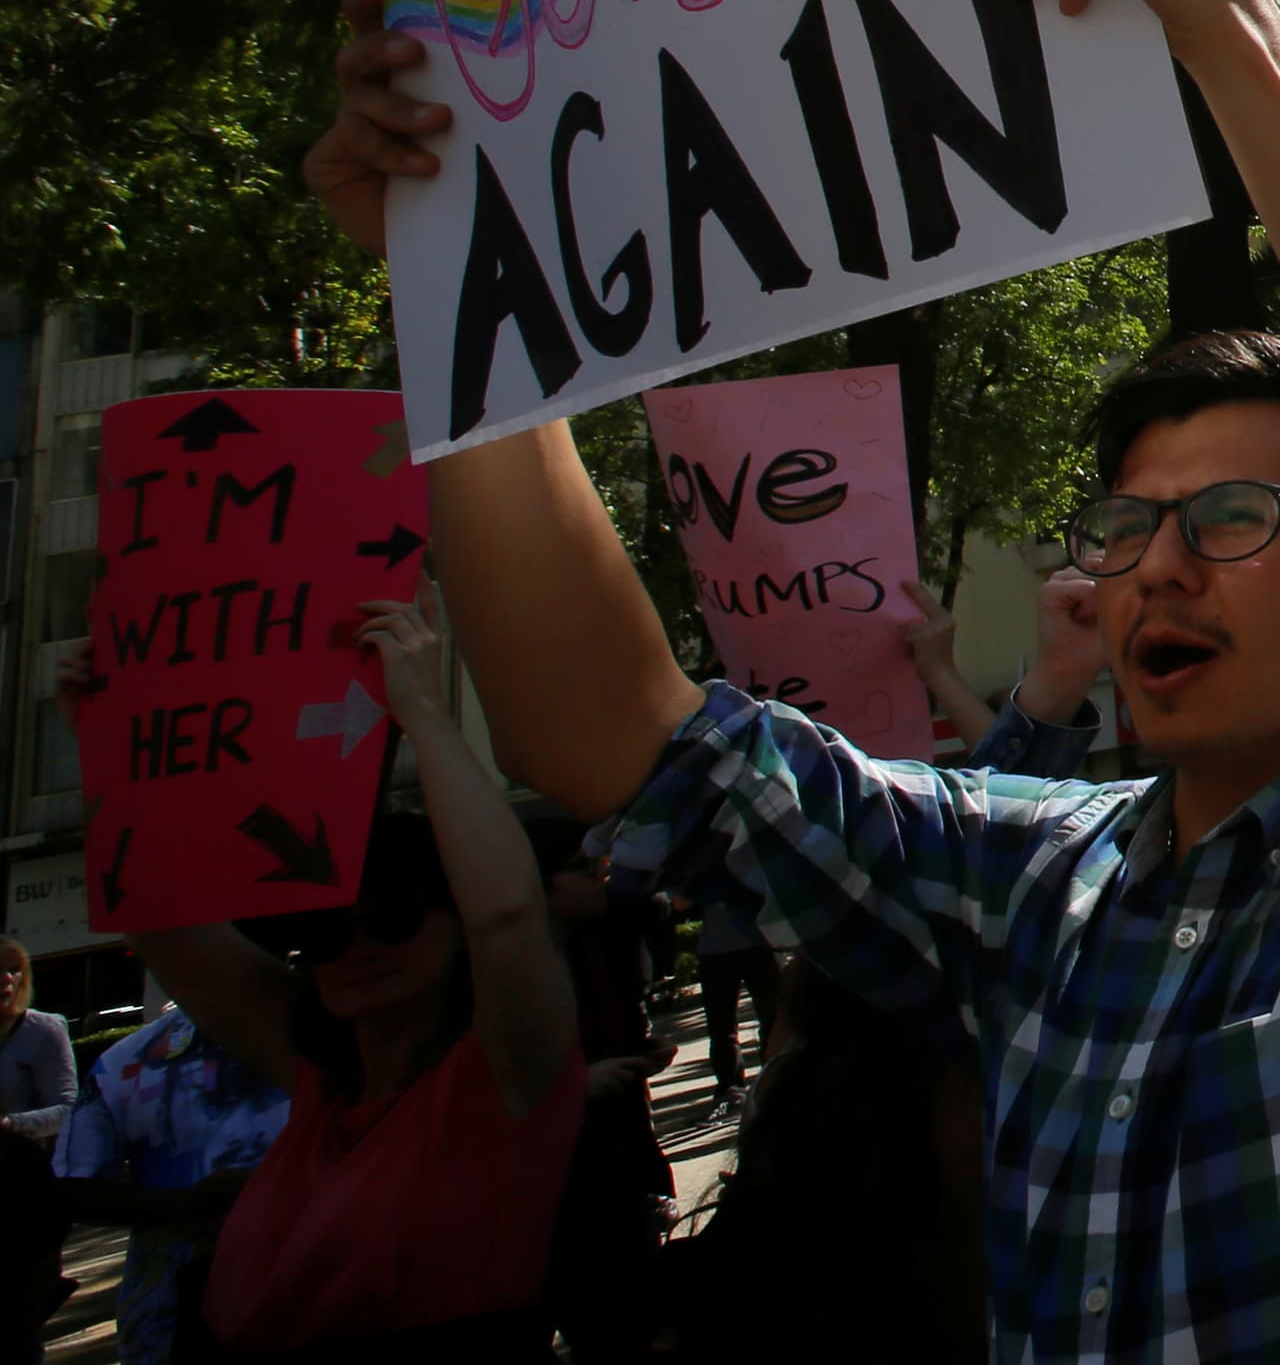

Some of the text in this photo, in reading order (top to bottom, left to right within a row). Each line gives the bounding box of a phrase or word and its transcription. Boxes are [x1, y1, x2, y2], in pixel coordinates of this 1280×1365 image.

[121, 463, 296, 556] I'M
[669, 449, 849, 543] ove
[109, 579, 313, 667] WITH
[694, 557, 885, 618] RUMPS
[129, 697, 255, 783] HER
